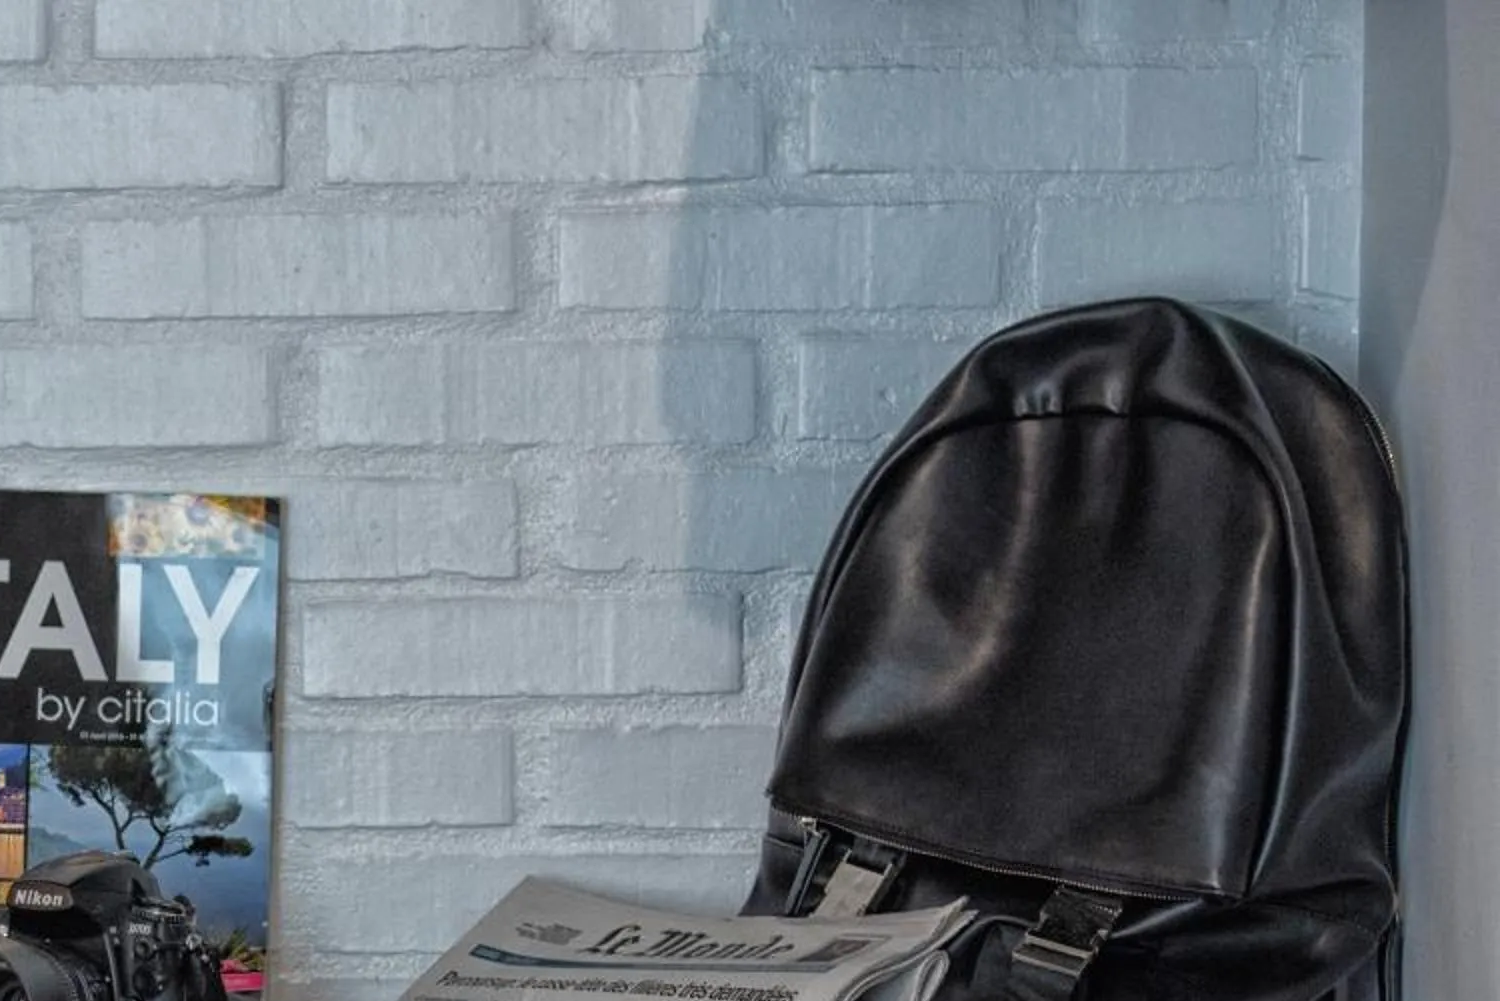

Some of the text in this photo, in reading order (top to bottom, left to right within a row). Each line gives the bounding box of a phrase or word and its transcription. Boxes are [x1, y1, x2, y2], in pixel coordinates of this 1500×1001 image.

[36, 687, 220, 730] by citalia
[15, 889, 64, 907] Nikon
[580, 924, 794, 960] Le Monde
